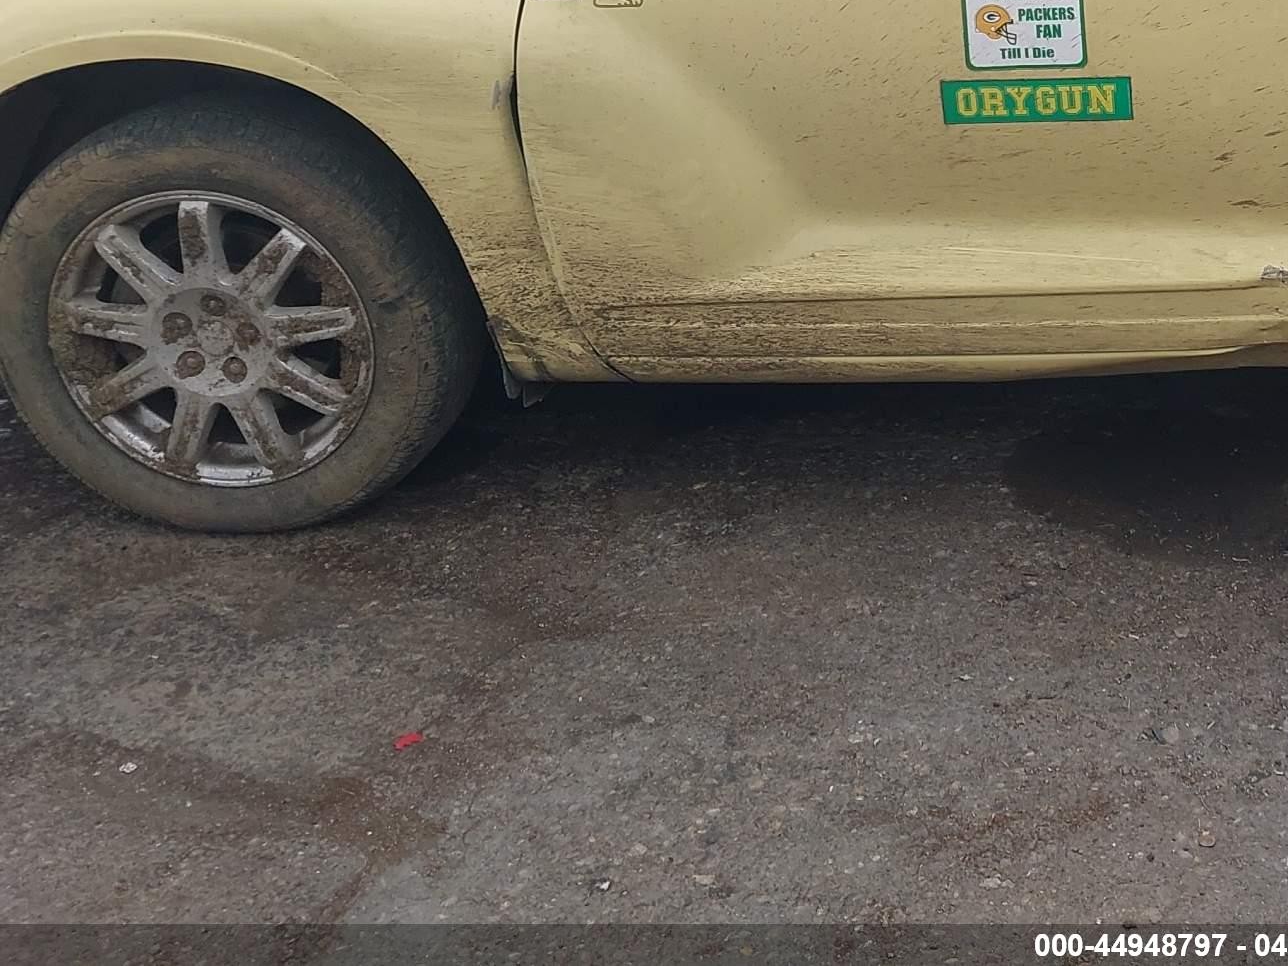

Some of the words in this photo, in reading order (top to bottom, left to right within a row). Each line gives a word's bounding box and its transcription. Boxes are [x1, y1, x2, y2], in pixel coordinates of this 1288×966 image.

[1017, 6, 1075, 22] PACKERS
[1035, 23, 1062, 39] FAN
[1000, 47, 1021, 60] Till
[1025, 47, 1030, 59] I
[1032, 46, 1055, 59] Die
[955, 84, 1116, 117] ORYGUN
